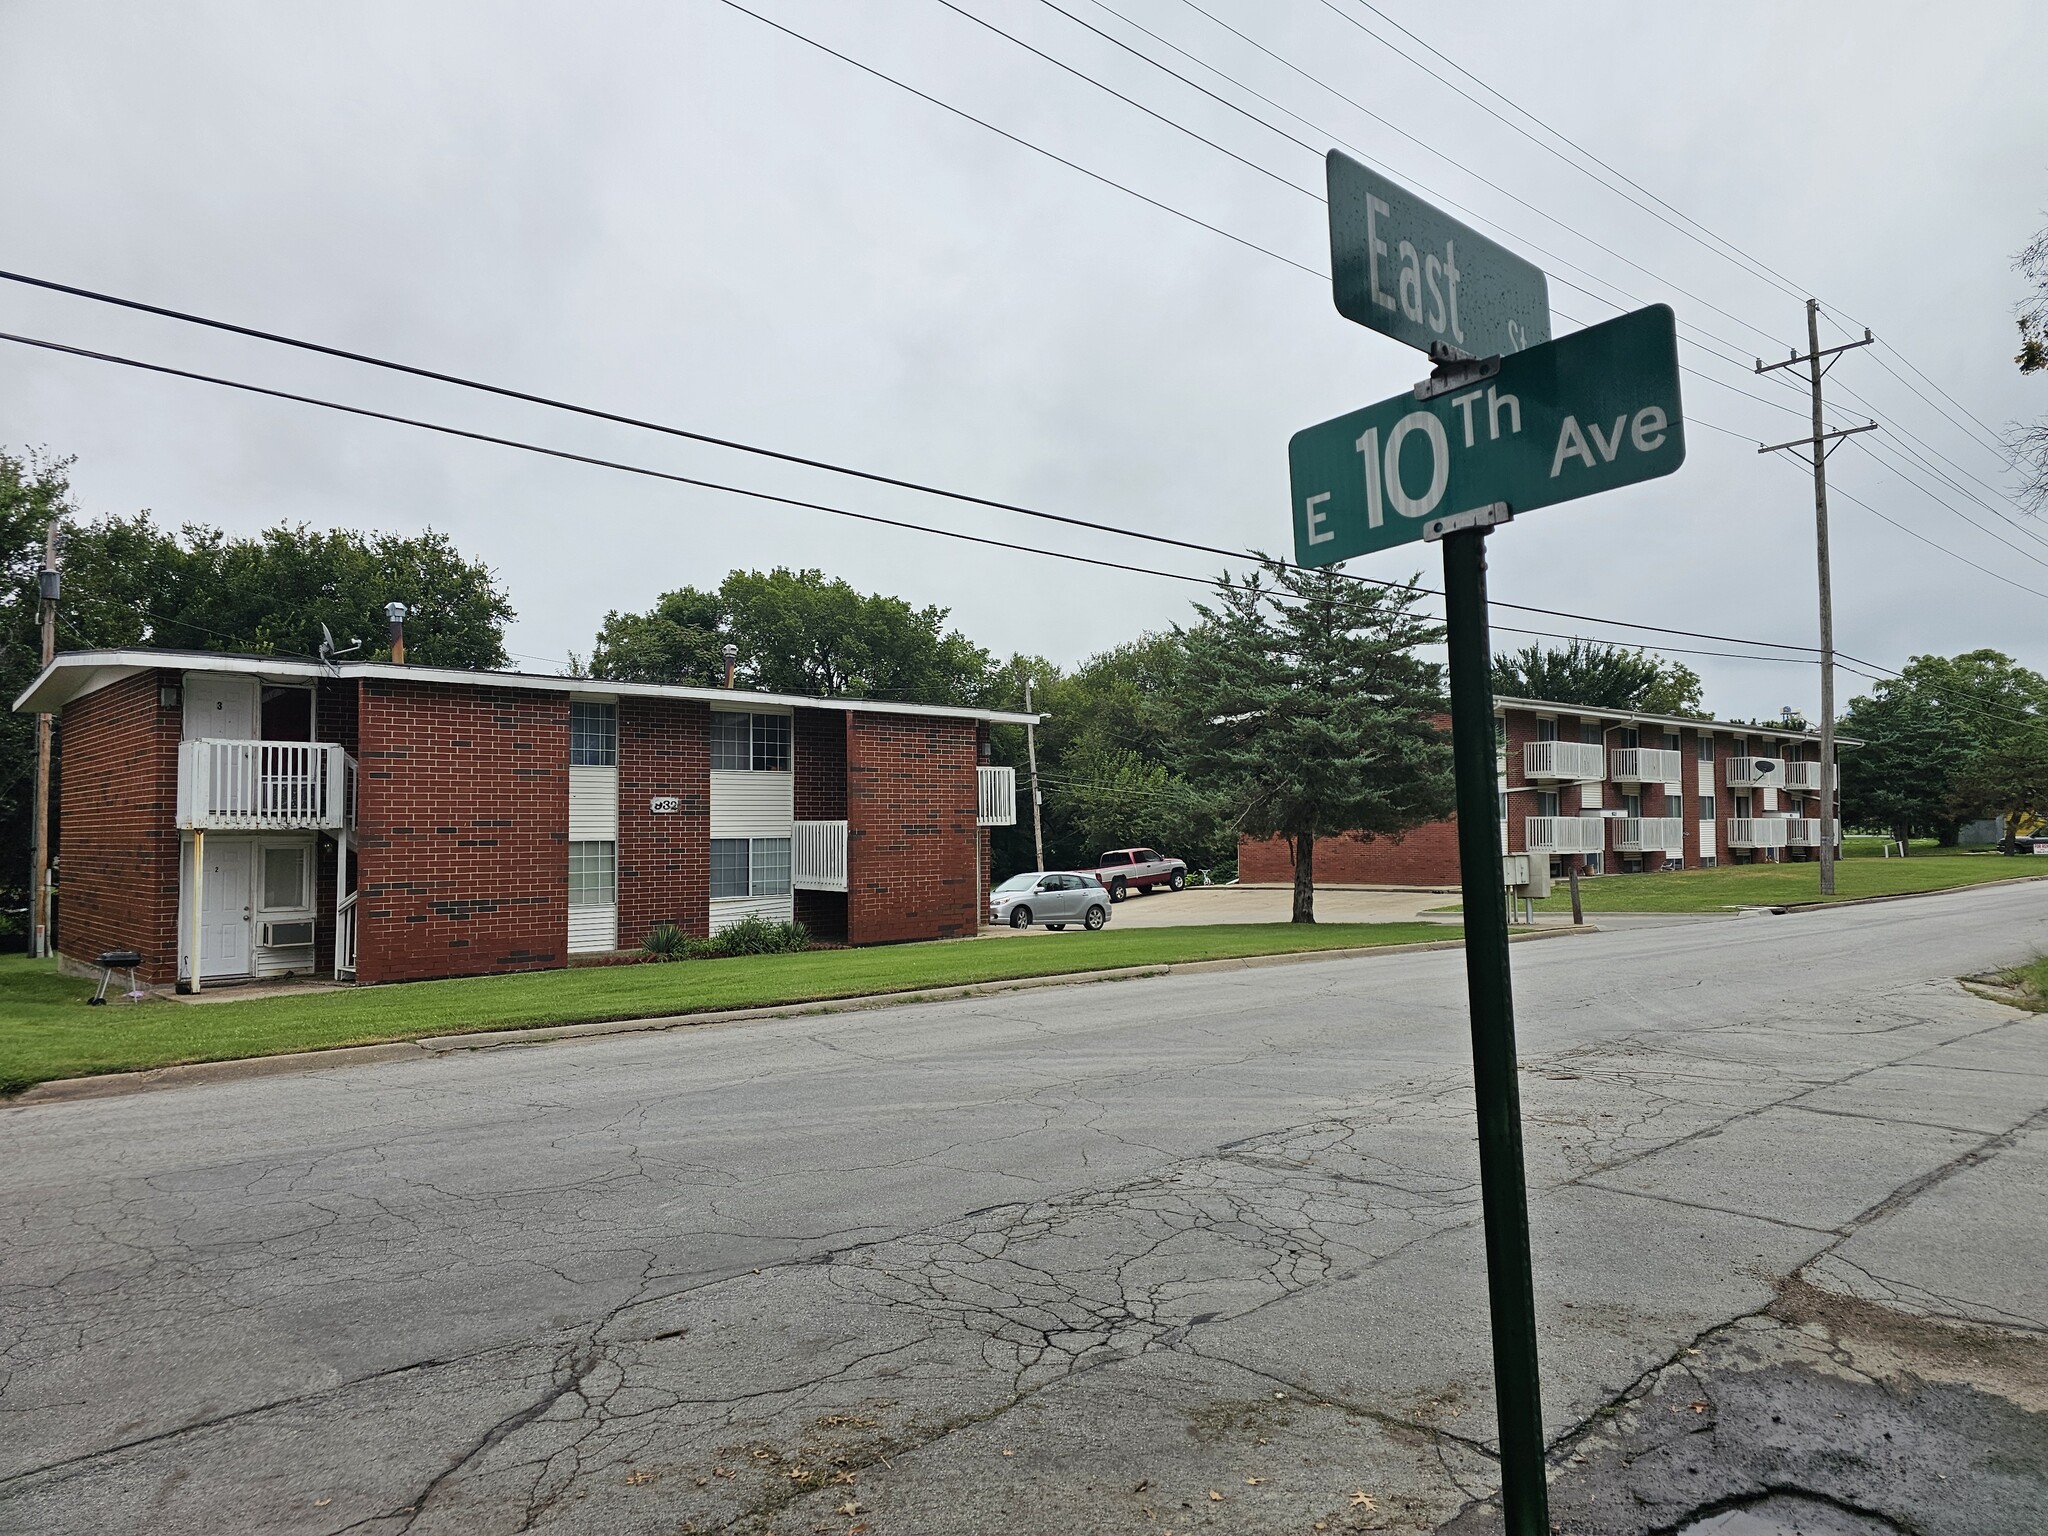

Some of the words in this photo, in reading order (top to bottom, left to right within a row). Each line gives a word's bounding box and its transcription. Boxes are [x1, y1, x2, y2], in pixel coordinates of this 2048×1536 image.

[1366, 193, 1463, 343] East
[1307, 492, 1335, 546] E
[1550, 405, 1668, 479] Ave
[217, 701, 222, 710] 3
